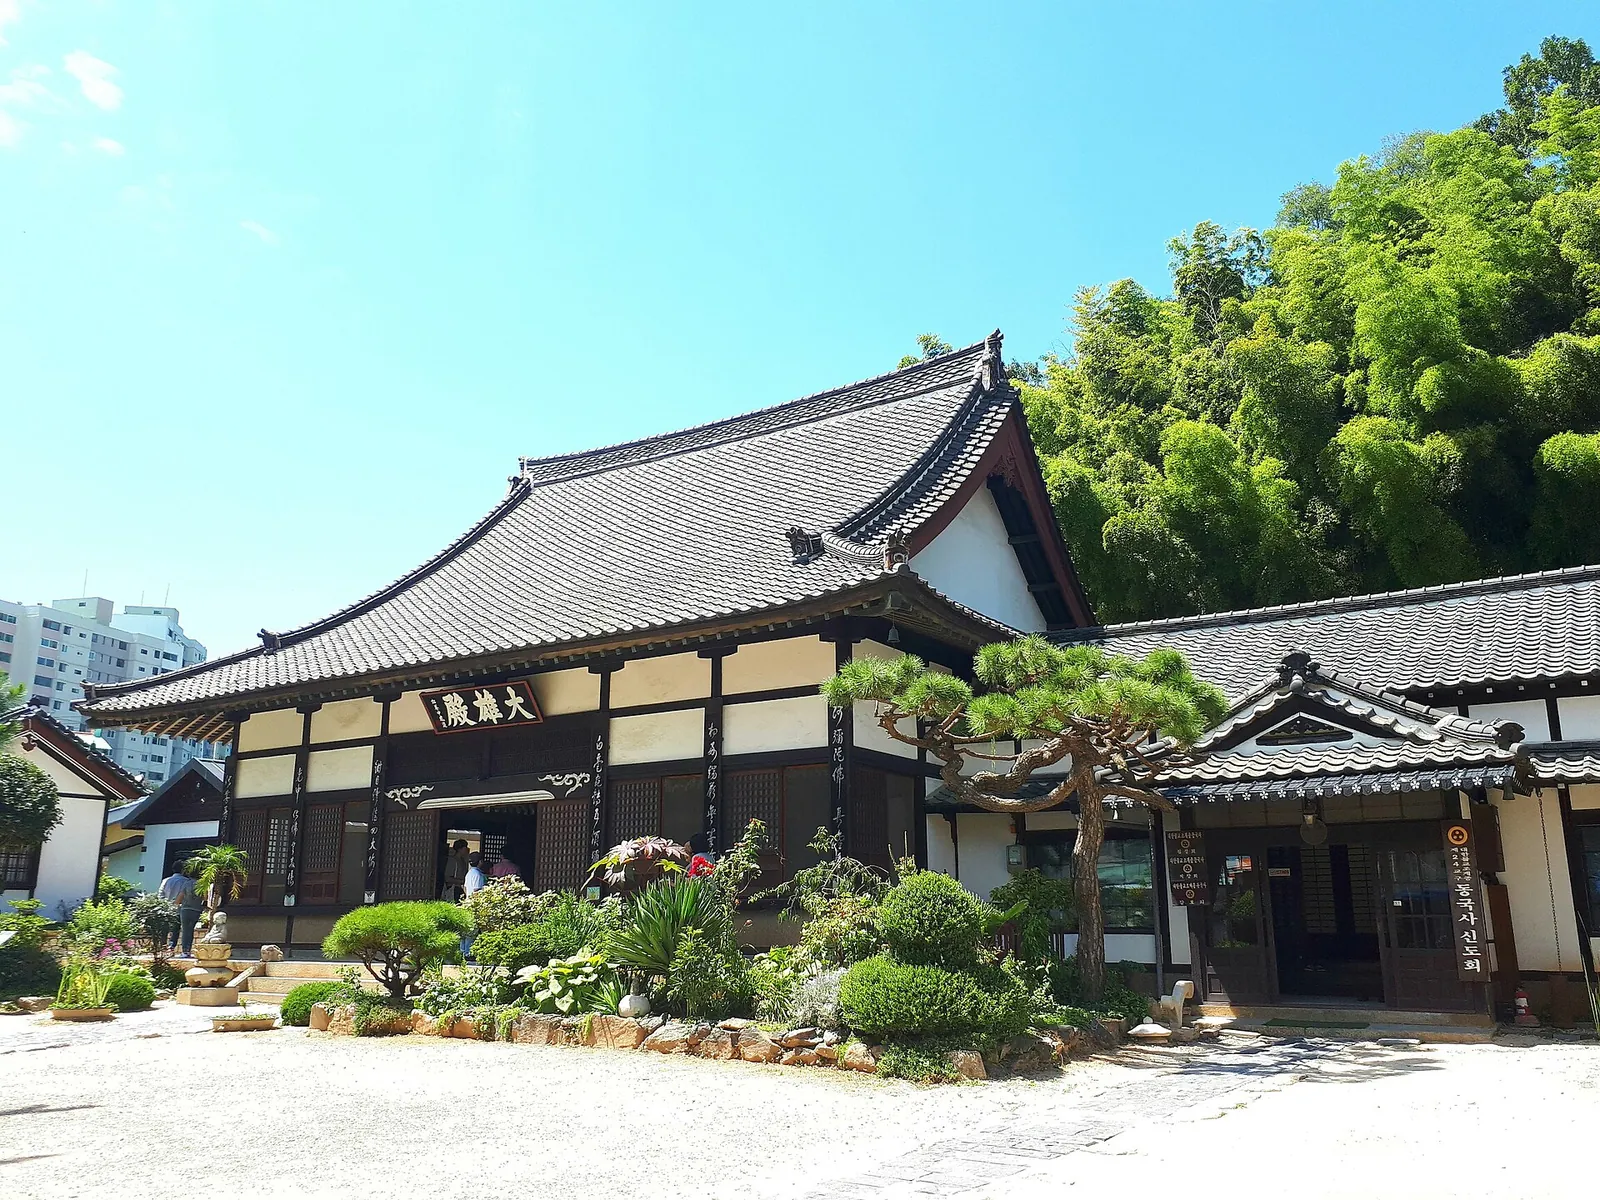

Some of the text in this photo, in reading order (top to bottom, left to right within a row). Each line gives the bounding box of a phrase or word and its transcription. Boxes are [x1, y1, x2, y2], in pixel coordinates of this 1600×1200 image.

[441, 686, 537, 727] 大雄殿
[1454, 883, 1482, 973] 동국사 신도회
